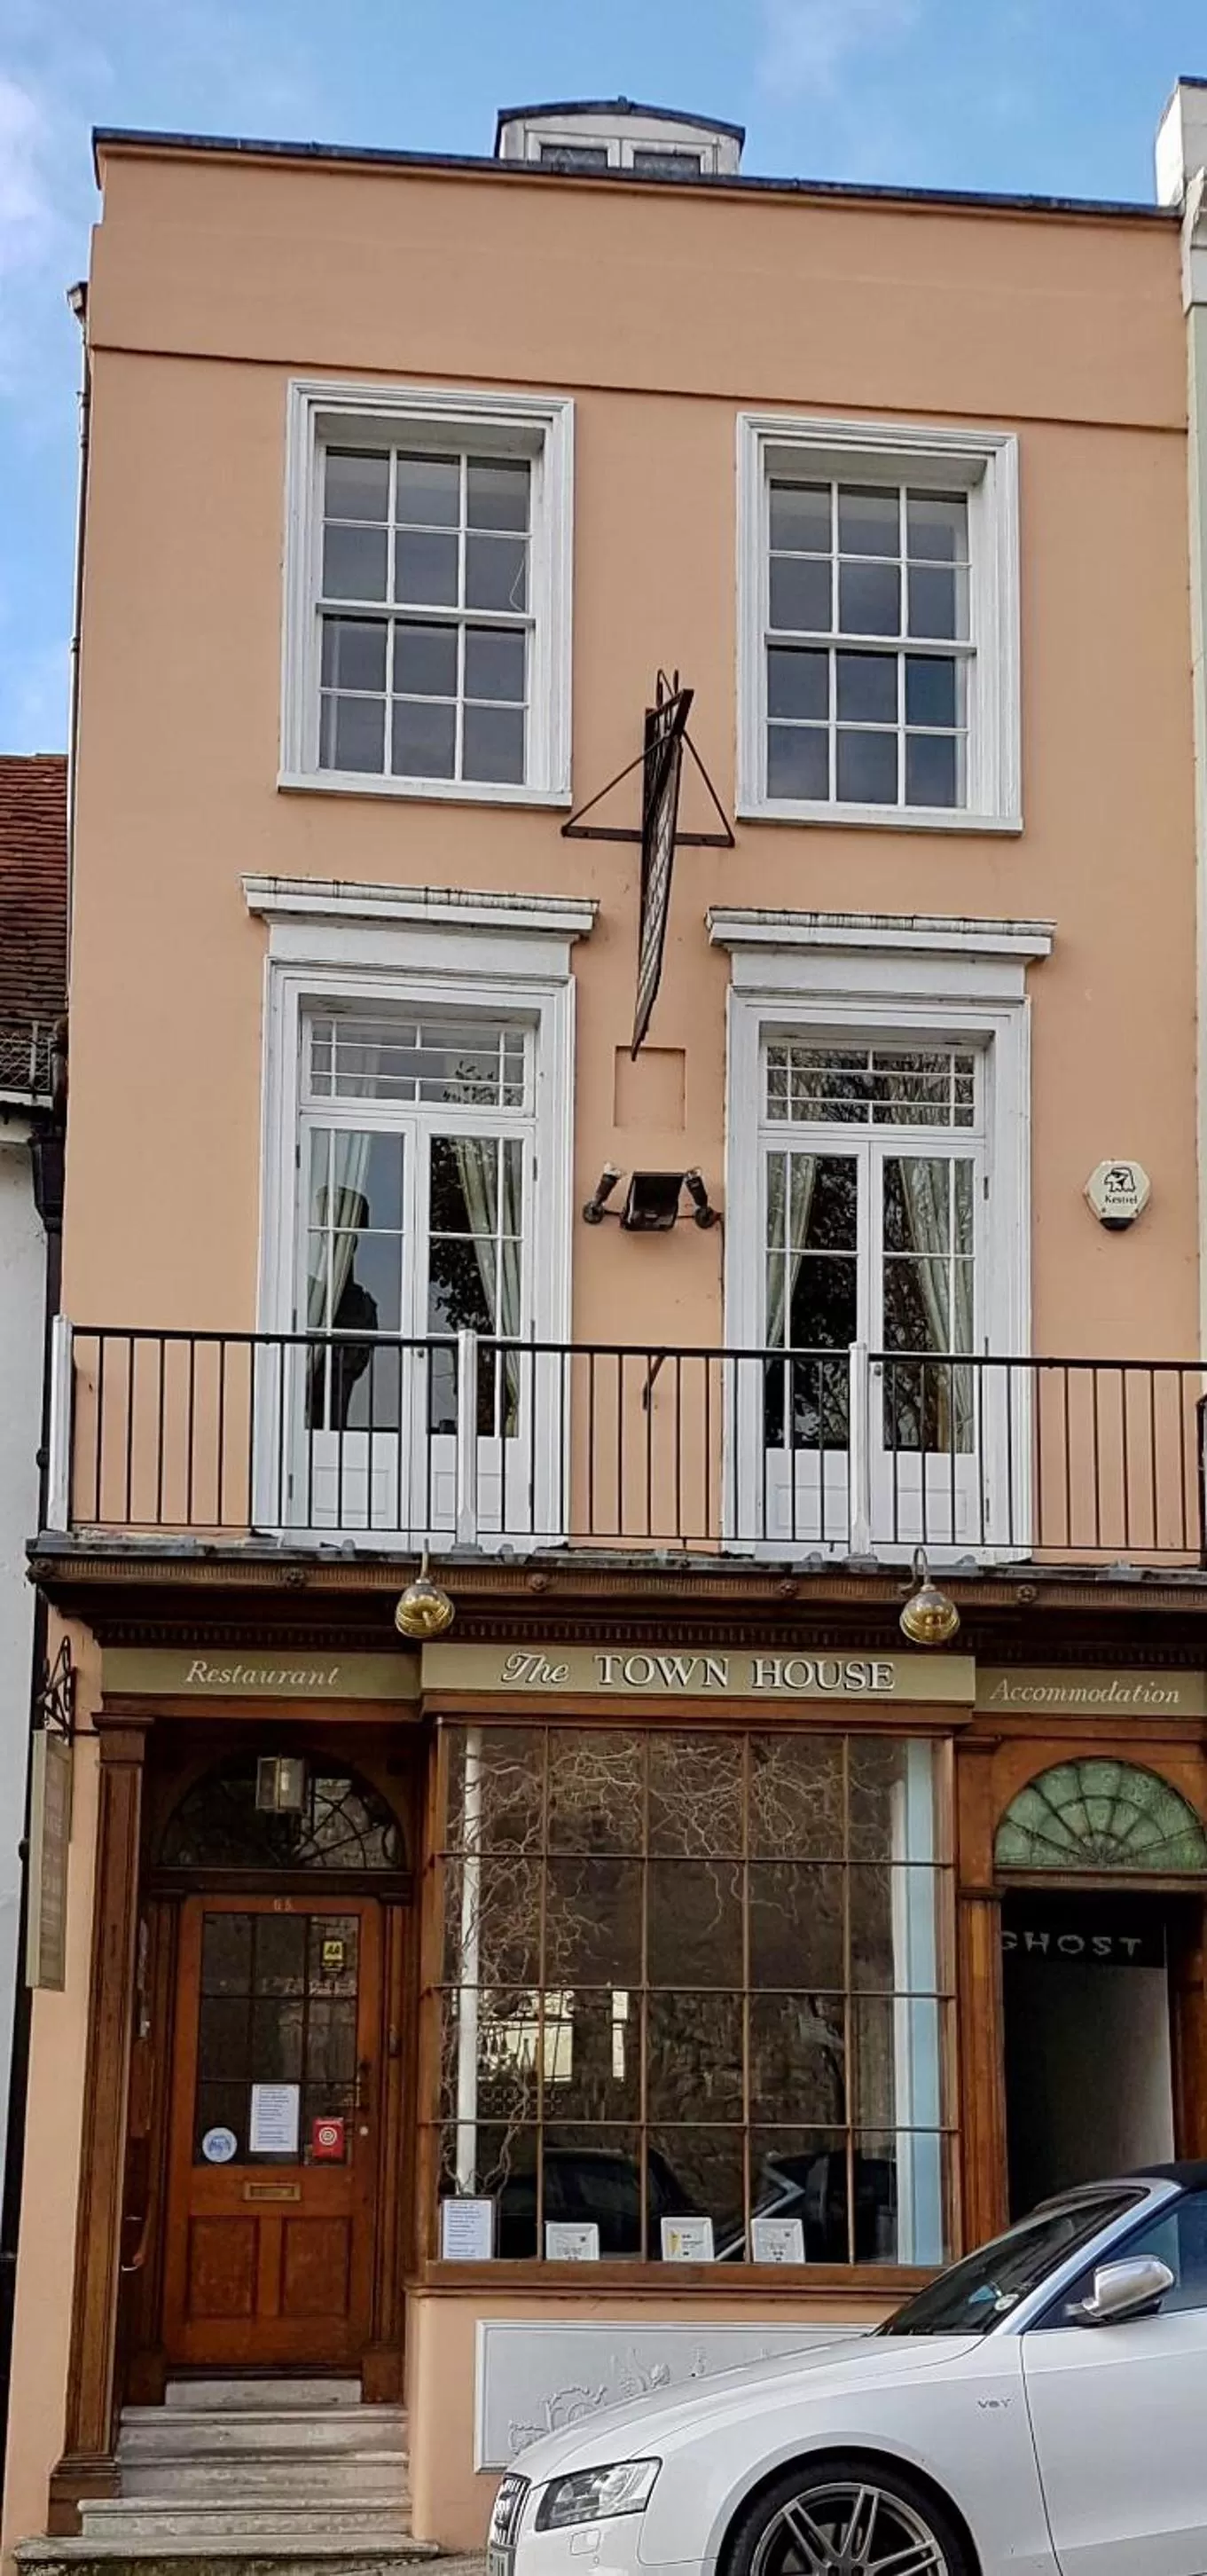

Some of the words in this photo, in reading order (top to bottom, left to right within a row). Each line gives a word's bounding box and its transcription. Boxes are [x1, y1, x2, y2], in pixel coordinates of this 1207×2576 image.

[1104, 1195, 1138, 1205] Kestrel
[185, 1660, 341, 1685] Restaurant
[501, 1651, 570, 1685] The
[593, 1653, 729, 1687] TOWN
[752, 1658, 896, 1692] HOUSE
[989, 1678, 1181, 1704] Accommodation
